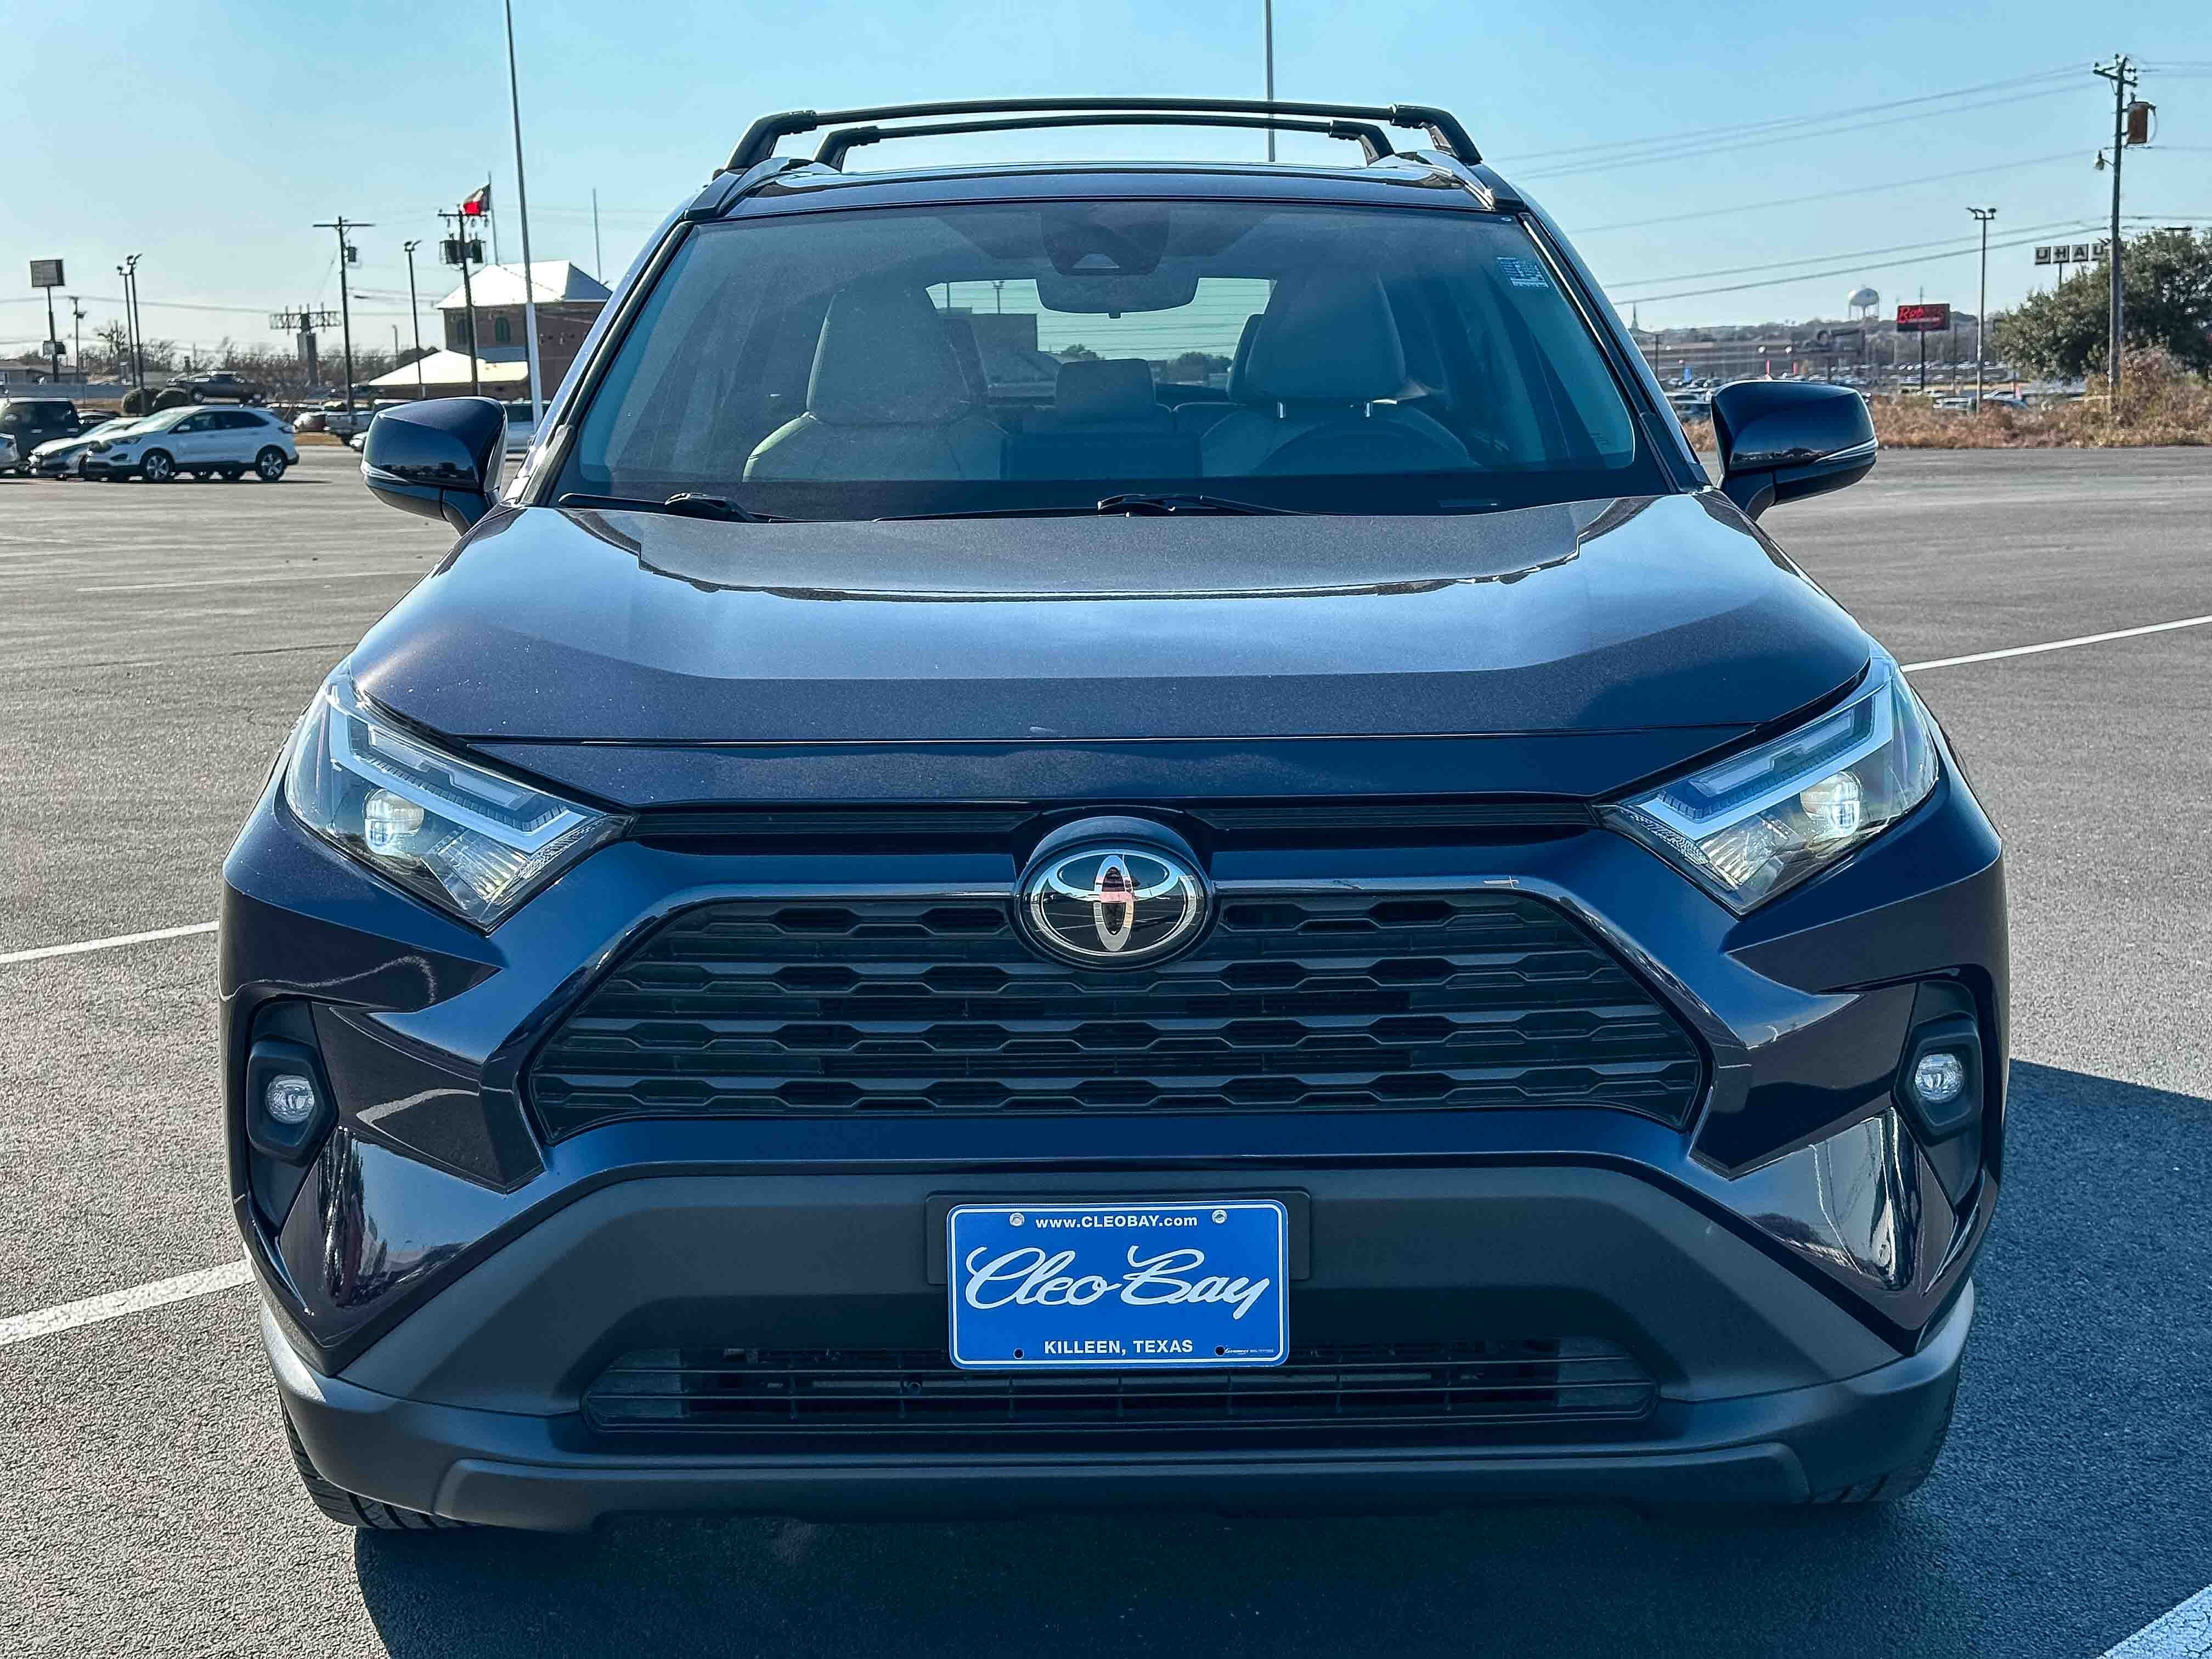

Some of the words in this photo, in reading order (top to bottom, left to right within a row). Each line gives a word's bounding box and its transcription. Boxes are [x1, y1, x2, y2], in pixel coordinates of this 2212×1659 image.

[2035, 244, 2106, 260] UHAU
[1035, 1215, 1198, 1228] www.CLEOBAY.com
[966, 1246, 1121, 1310] Cleo
[1120, 1245, 1270, 1320] Bay
[1044, 1340, 1127, 1356] KILLEEN,
[1133, 1339, 1193, 1353] TEXAS
